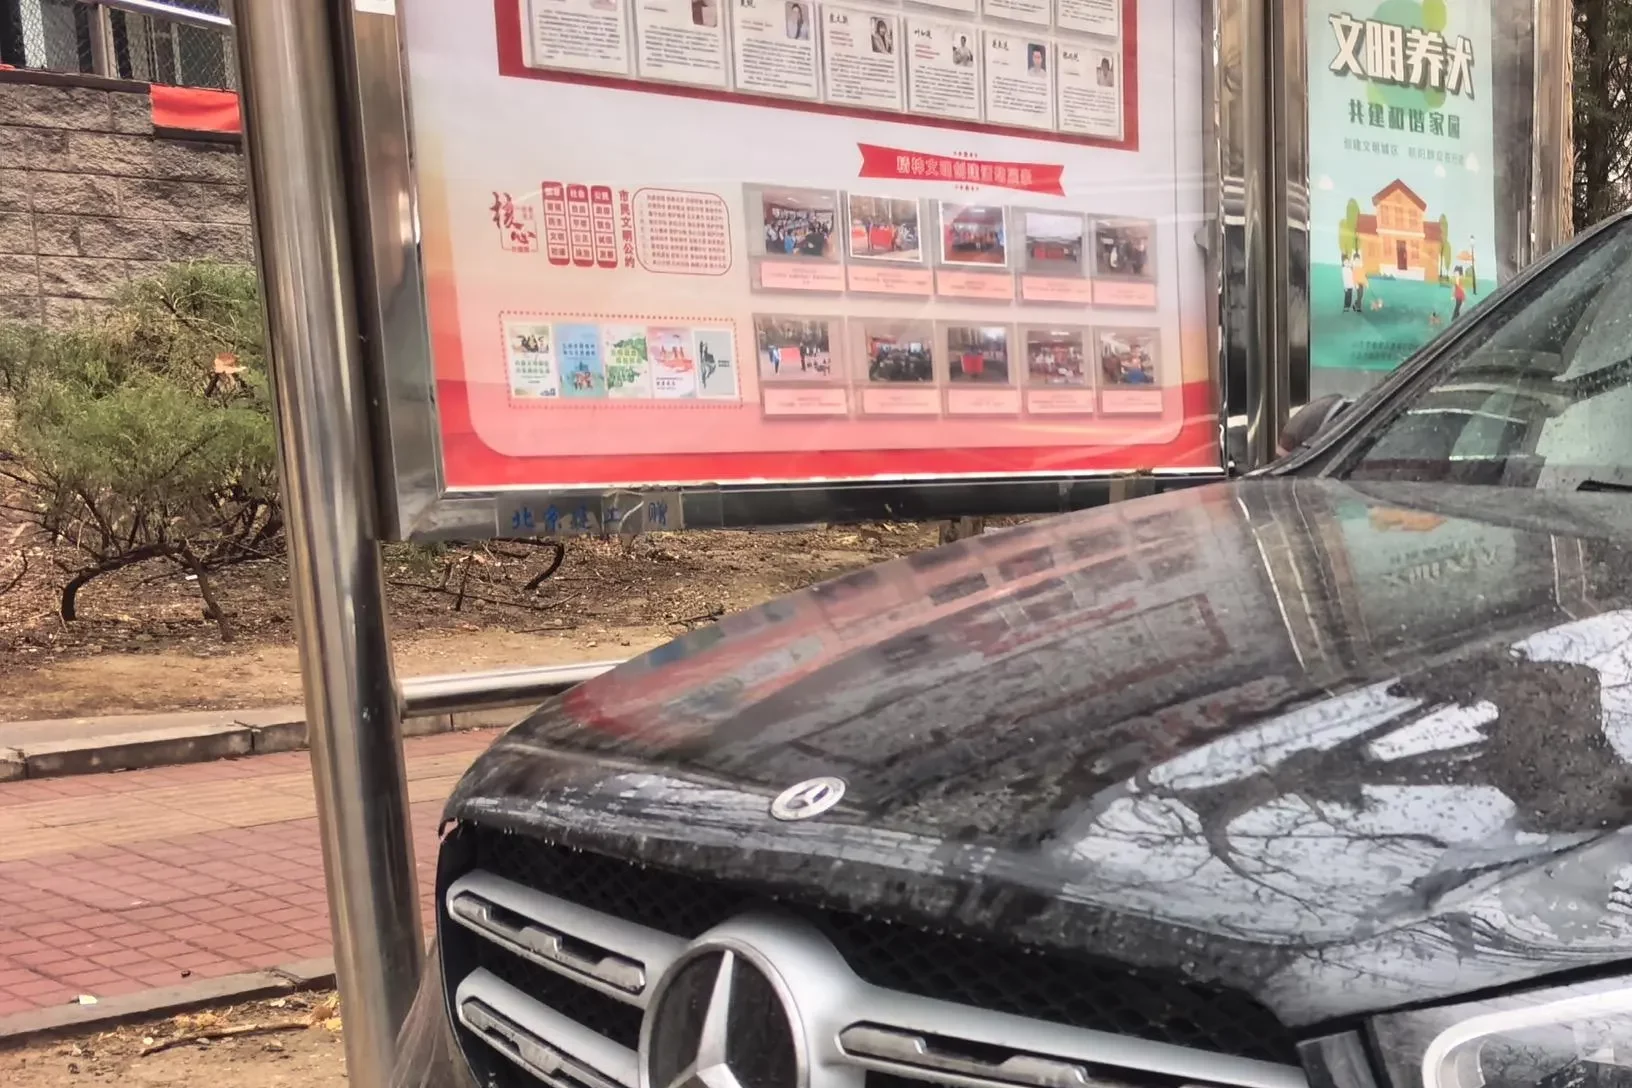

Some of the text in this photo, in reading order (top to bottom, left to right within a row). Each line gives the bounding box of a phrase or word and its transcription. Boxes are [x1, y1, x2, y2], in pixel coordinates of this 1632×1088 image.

[1328, 12, 1475, 100] 文明养犬
[1348, 98, 1461, 139] 共建和谐家园
[618, 189, 635, 268] 市民文明公约
